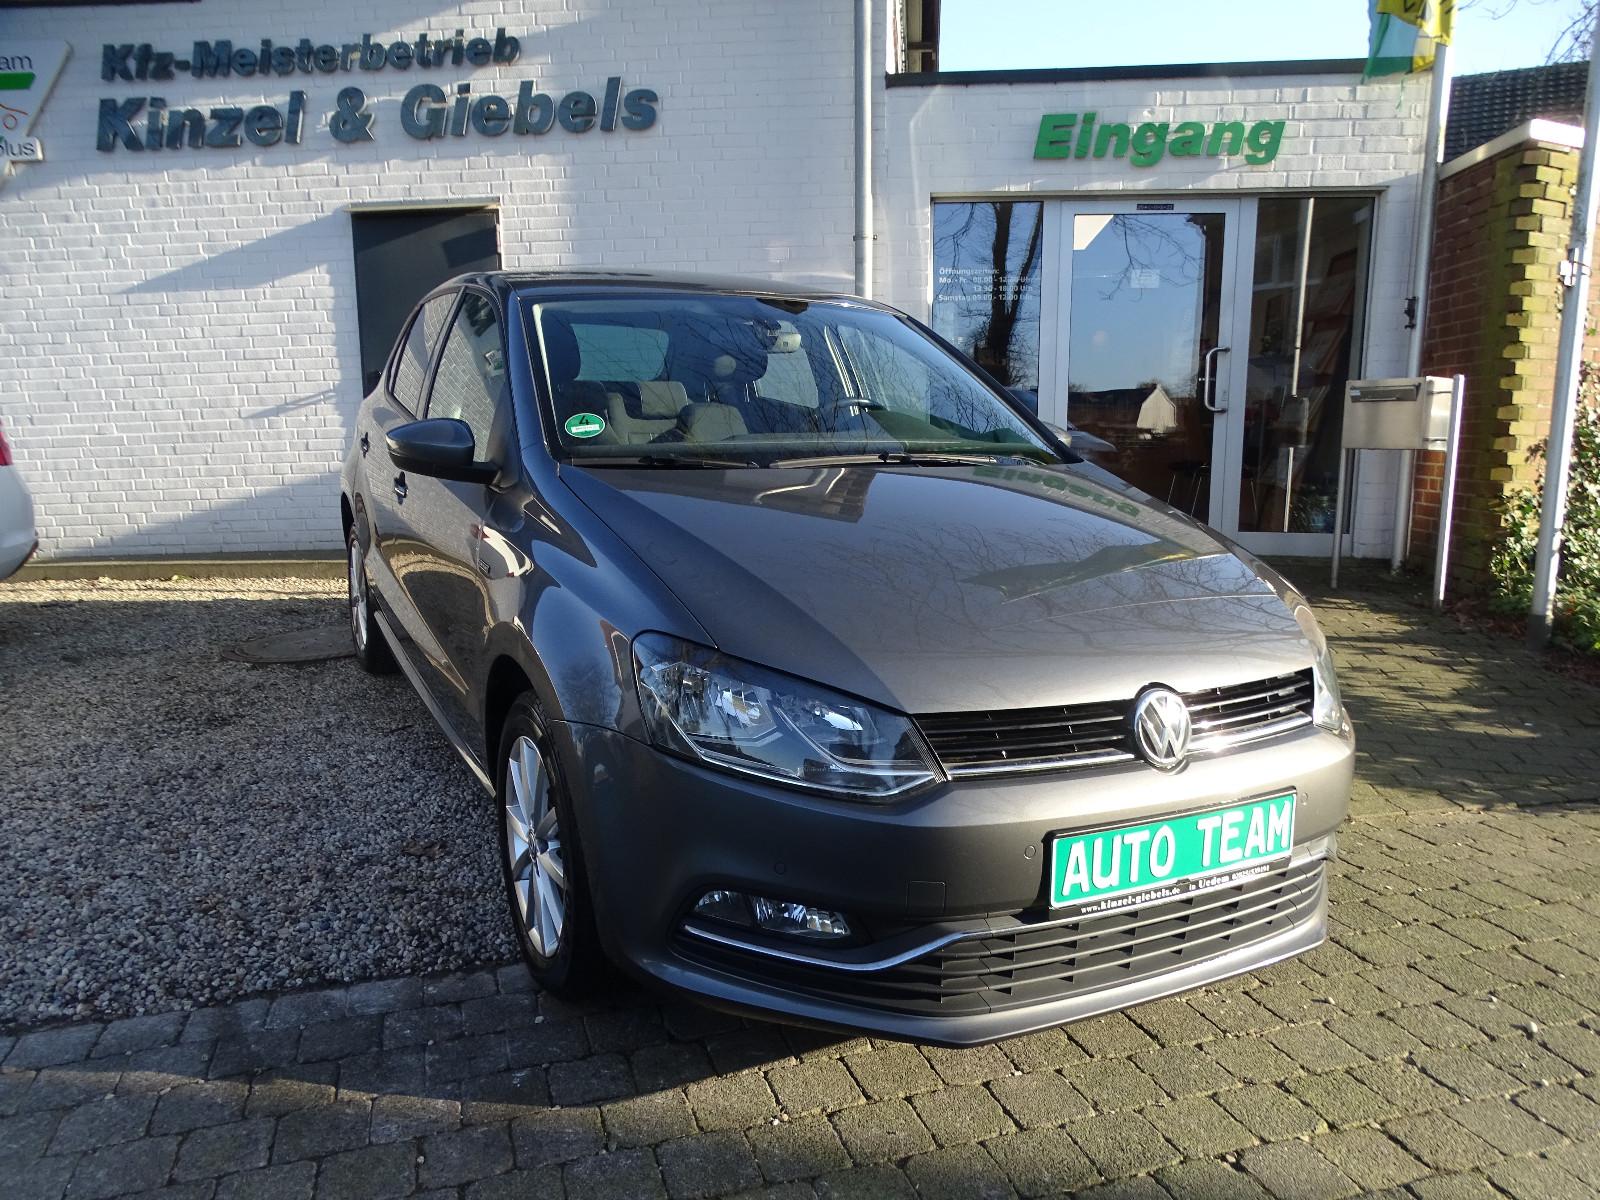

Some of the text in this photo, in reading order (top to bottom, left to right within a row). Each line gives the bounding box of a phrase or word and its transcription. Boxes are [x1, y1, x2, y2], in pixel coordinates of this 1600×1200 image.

[102, 27, 520, 82] Kfz-Meisterbetrieb
[97, 76, 659, 153] Kinzel & Giebels
[1034, 112, 1286, 168] Eingang
[0, 138, 37, 157] lus
[579, 415, 590, 425] 4
[1062, 800, 1291, 897] AUTO TEAM
